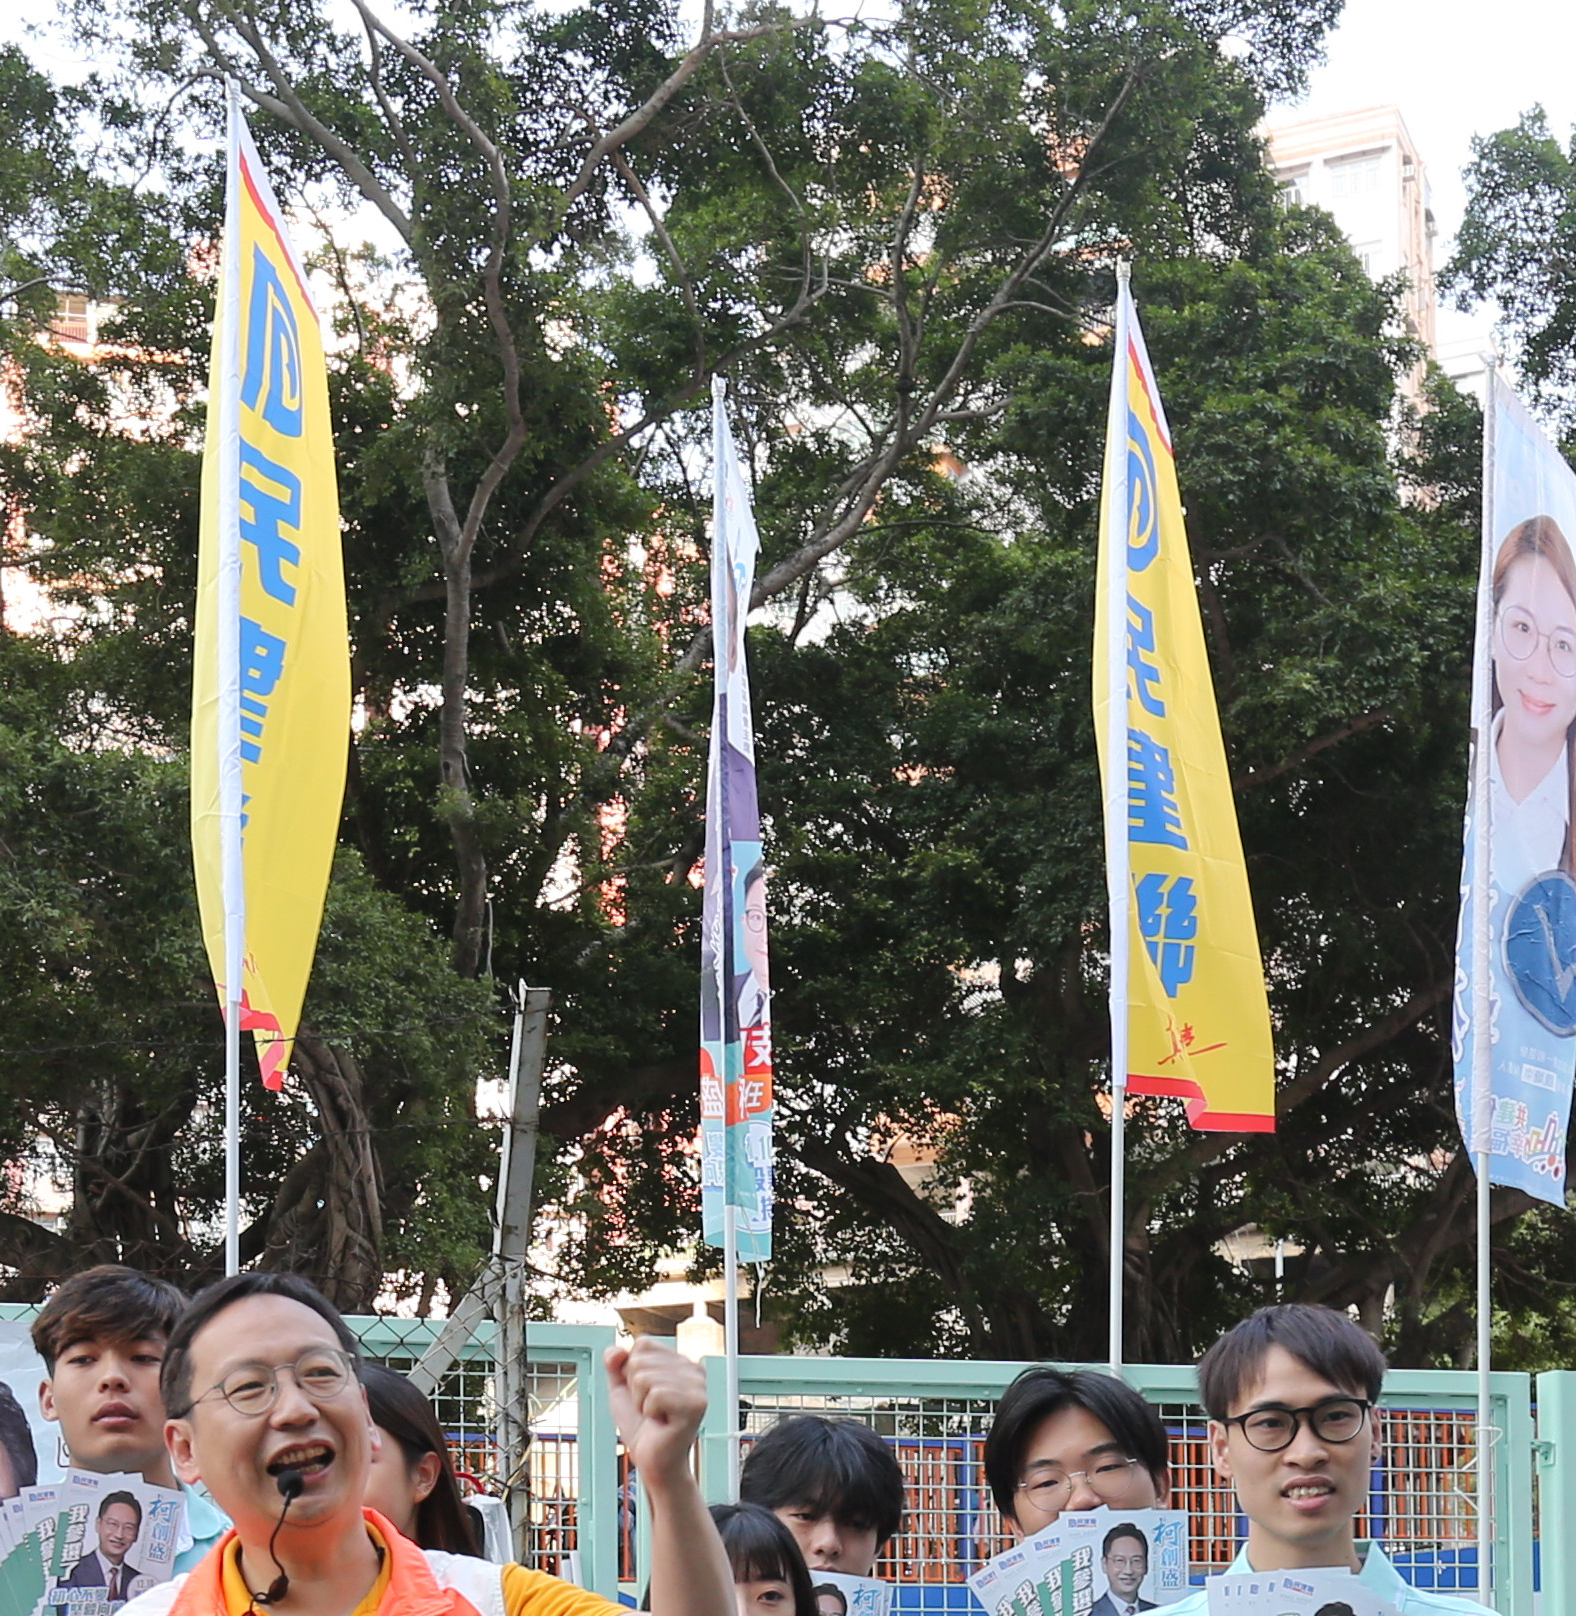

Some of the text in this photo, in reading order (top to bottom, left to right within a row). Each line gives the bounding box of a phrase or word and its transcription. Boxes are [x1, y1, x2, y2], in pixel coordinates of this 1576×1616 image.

[148, 1494, 177, 1561] 柯創盛
[1153, 1518, 1183, 1587] 柯創盛
